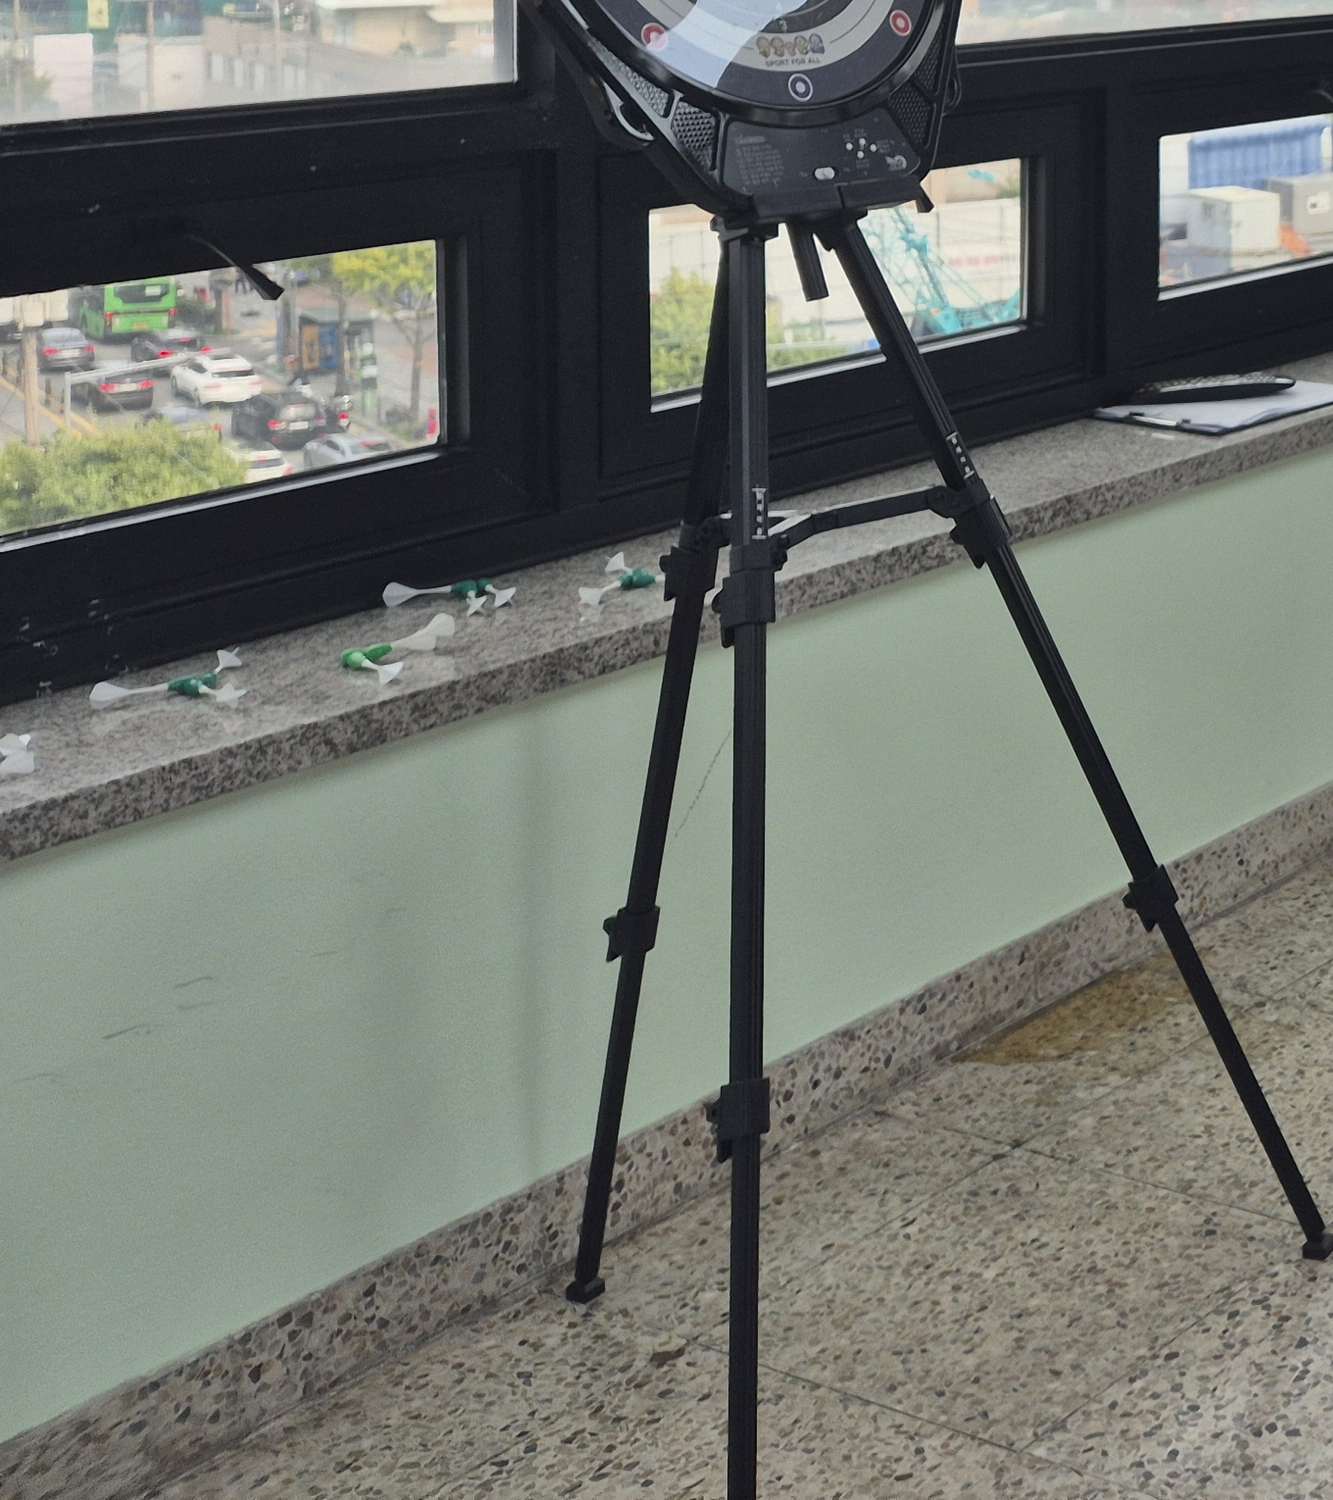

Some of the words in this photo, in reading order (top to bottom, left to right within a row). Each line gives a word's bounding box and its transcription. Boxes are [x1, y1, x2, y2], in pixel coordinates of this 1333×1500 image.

[765, 59, 790, 68] SPORT
[791, 58, 806, 66] FOR
[808, 56, 822, 65] ALL
